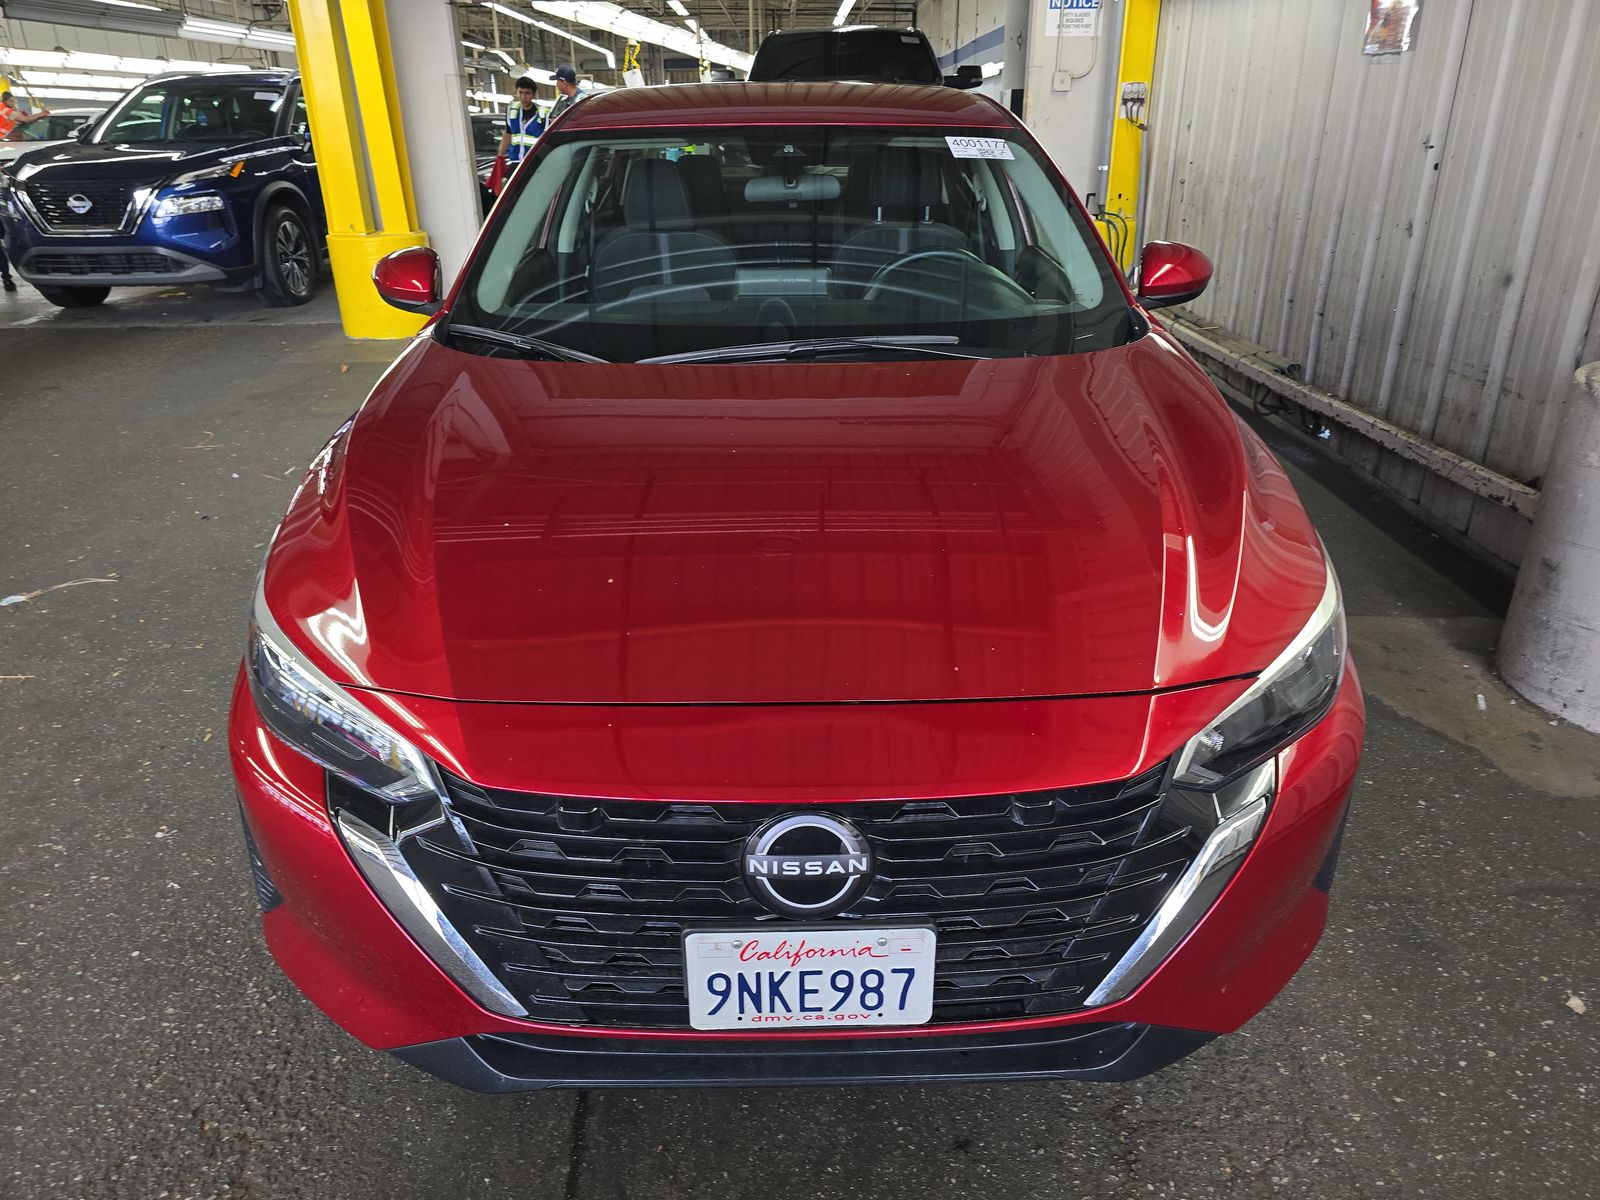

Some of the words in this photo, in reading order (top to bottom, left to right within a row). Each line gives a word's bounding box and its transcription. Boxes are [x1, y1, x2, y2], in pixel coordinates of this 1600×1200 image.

[1051, 0, 1099, 8] NOTICE
[952, 139, 1006, 148] 4001177
[749, 857, 867, 876] NISSAN
[739, 940, 888, 967] California
[707, 968, 915, 1015] 9NKE987
[751, 1012, 871, 1023] dmv.ca.gov
